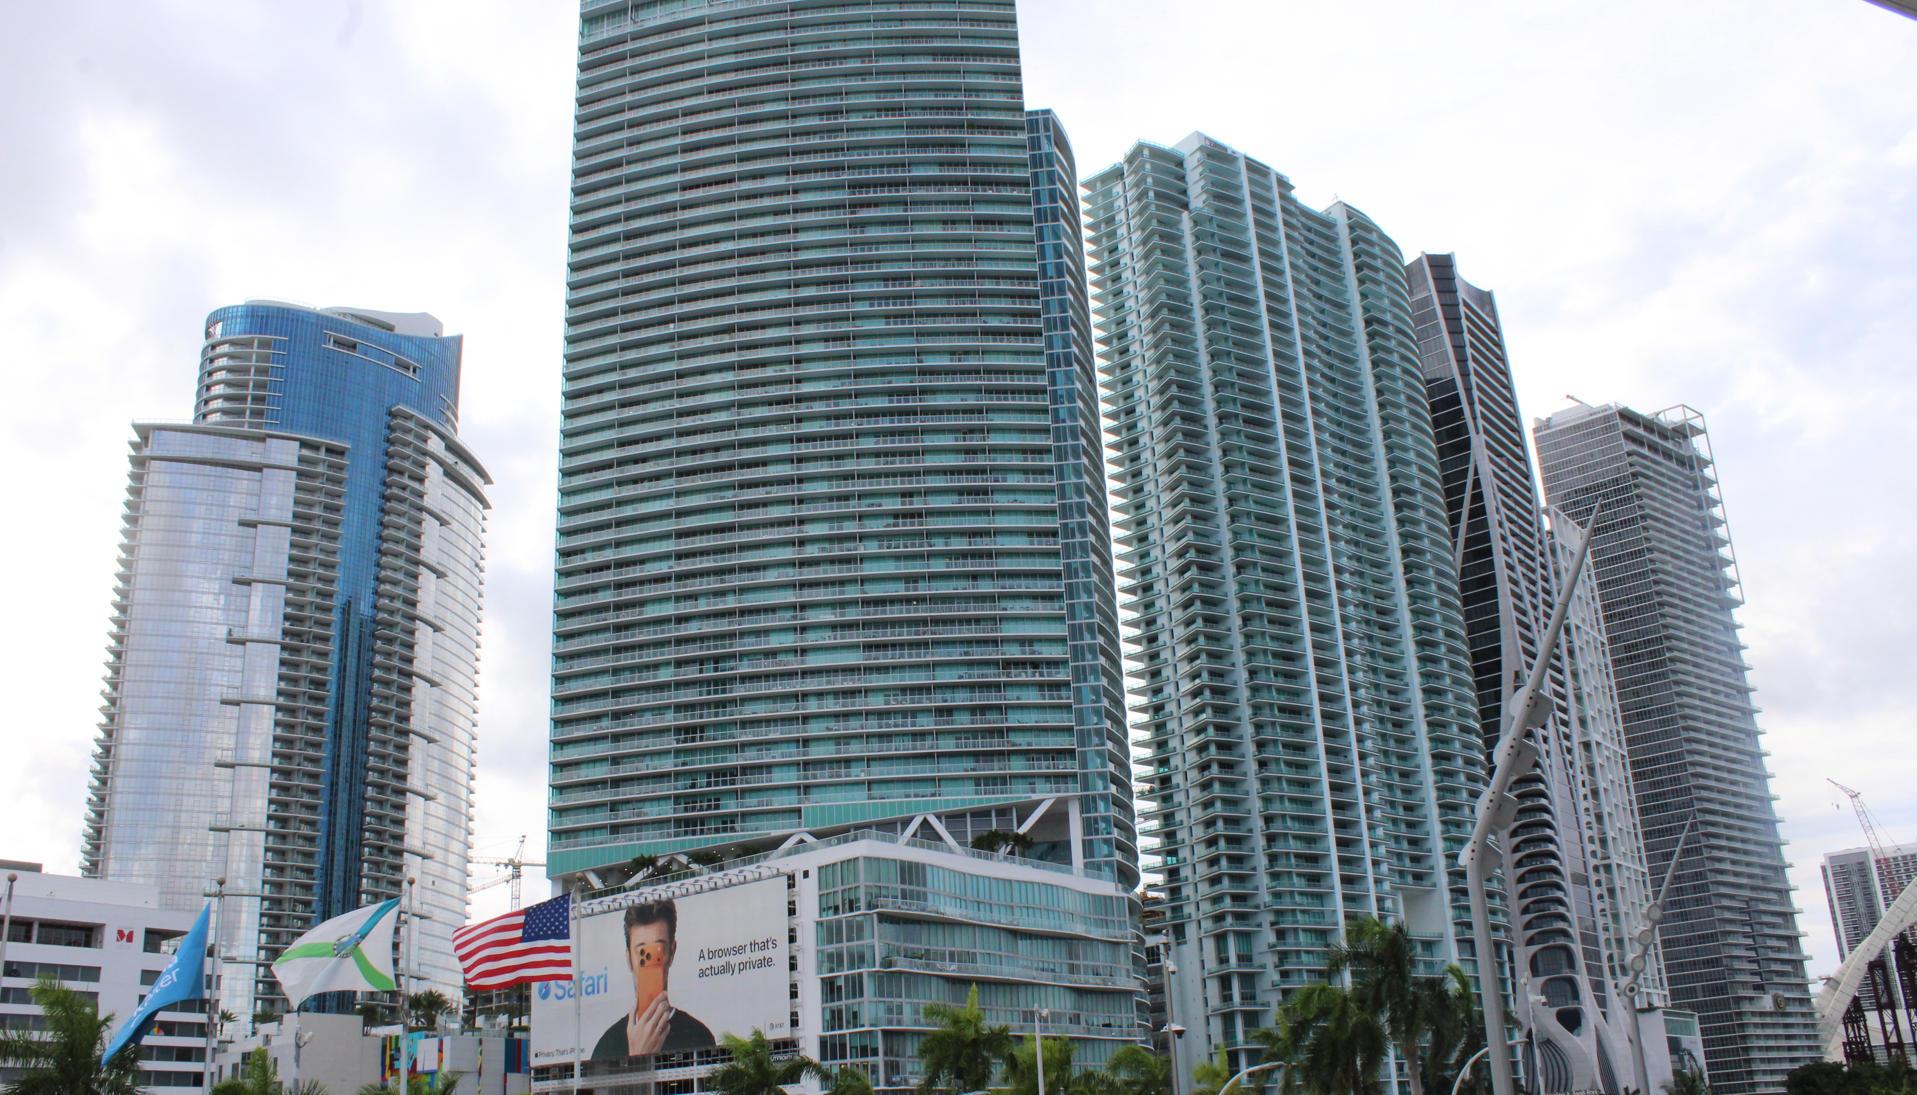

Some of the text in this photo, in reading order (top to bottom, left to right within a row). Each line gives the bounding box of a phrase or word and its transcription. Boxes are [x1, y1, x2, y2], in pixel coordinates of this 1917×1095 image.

[698, 937, 777, 962] A browser that's
[698, 957, 775, 978] actually private.
